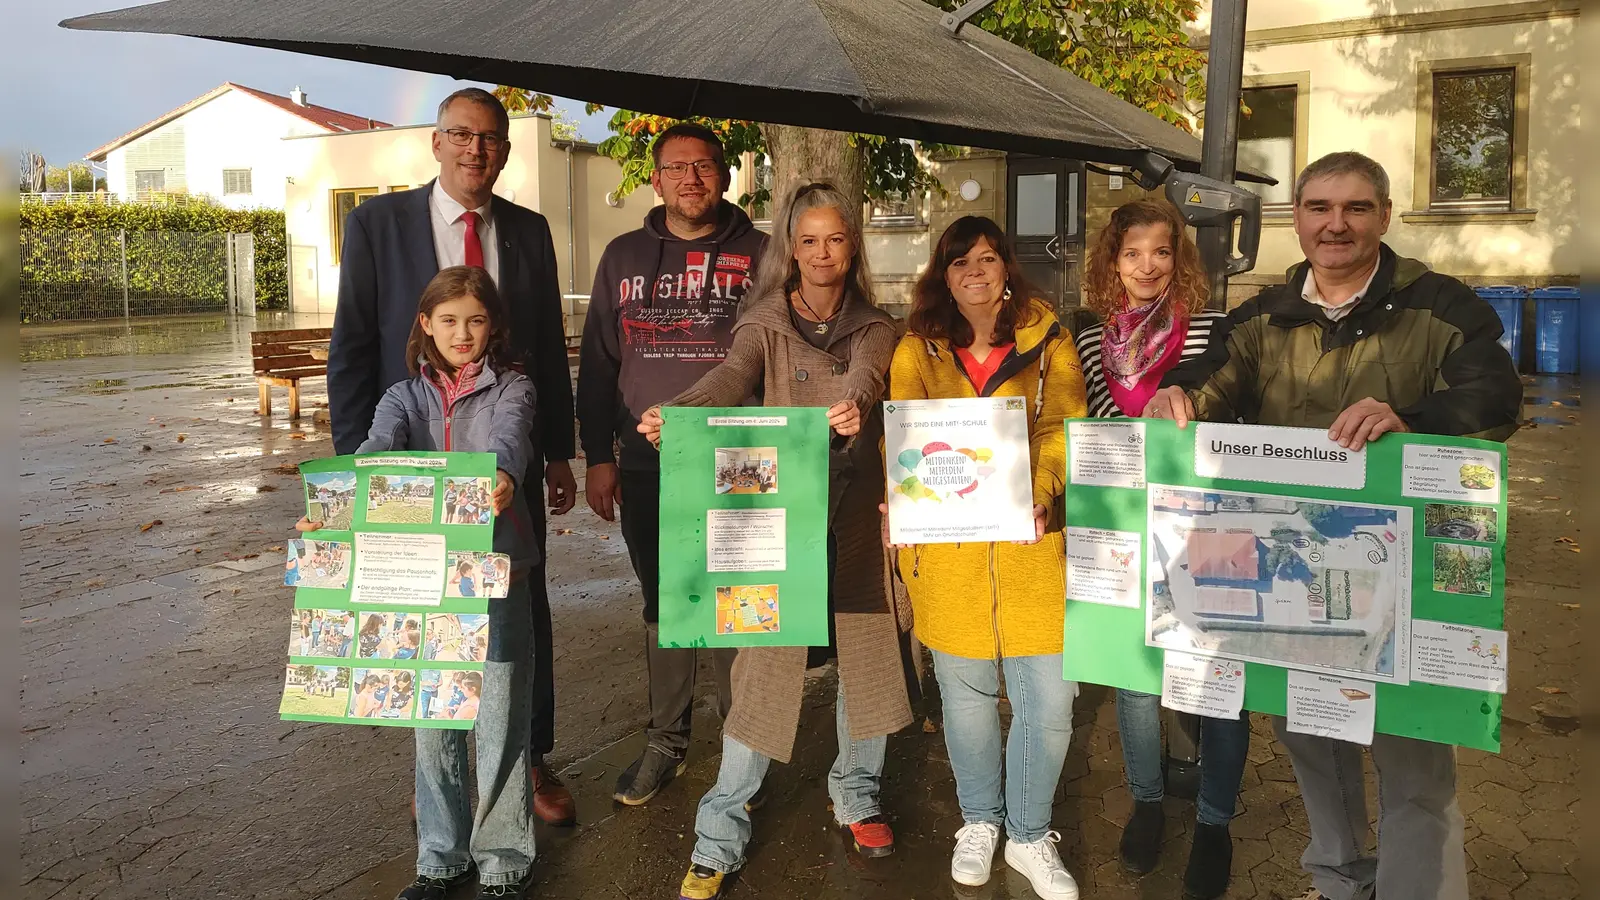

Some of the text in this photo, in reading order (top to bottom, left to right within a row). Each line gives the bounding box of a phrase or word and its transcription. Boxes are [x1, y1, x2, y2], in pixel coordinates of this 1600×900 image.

[1211, 440, 1348, 462] Unser Beschluss
[925, 456, 967, 466] MITDENKEN!
[929, 466, 964, 476] MITREDEN!
[923, 476, 973, 486] MITGESTALTEN!
[1467, 673, 1489, 681] abgebaut
